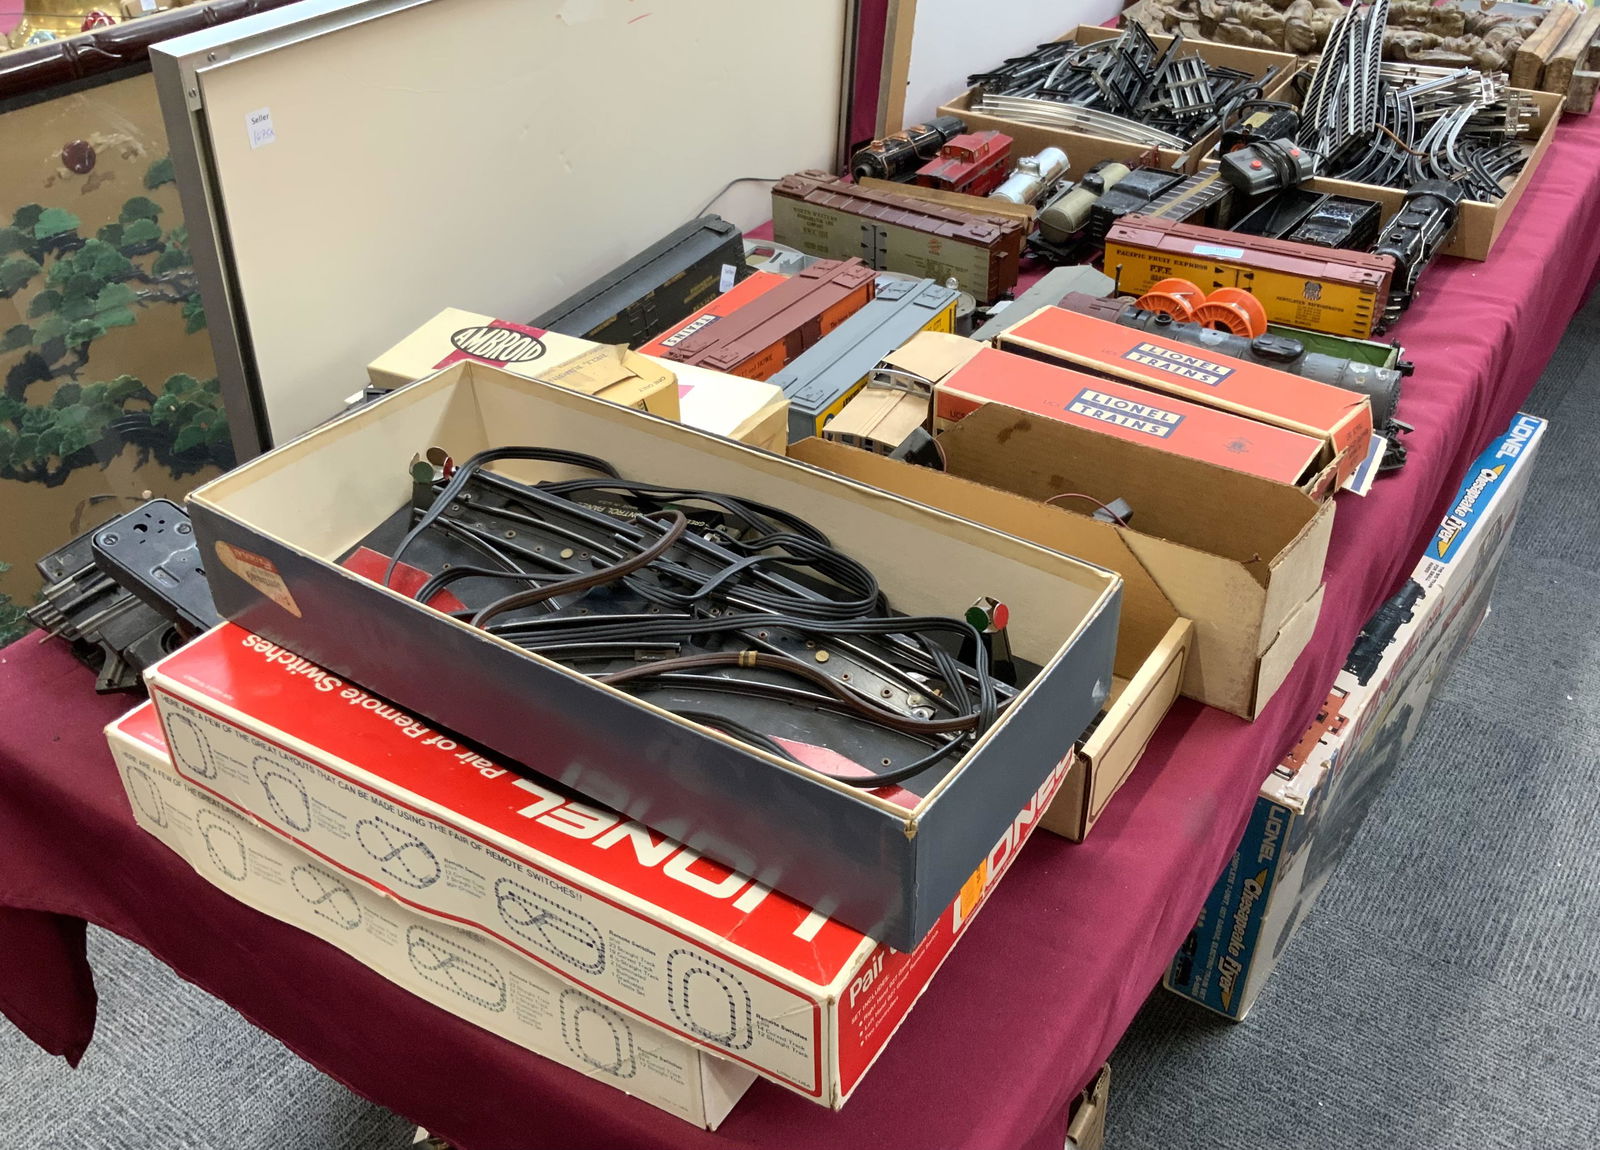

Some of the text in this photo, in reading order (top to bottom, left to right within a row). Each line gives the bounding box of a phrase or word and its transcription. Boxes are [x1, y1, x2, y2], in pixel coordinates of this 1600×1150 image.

[250, 113, 269, 125] Seller
[1116, 249, 1208, 270] PACIFIC FRUIT EXPRESS
[453, 328, 541, 362] AMBROID
[666, 316, 711, 346] TRAINS
[1135, 355, 1210, 383] TRAINS
[1146, 346, 1221, 374] LIONEL
[1080, 405, 1161, 434] TRAINS
[1091, 393, 1171, 422] LIONEL
[1496, 416, 1541, 459] LIONEL
[1438, 468, 1499, 544] Chesapeake Flyer
[241, 634, 343, 692] Switches
[340, 687, 432, 739] Remote
[421, 735, 458, 751] of
[455, 751, 509, 780] Pair
[161, 694, 181, 709] HERE
[182, 705, 198, 717] ARE
[203, 715, 221, 729] FEW
[222, 724, 233, 734] OF
[235, 729, 249, 743] THE
[250, 738, 277, 757] GREAT
[278, 752, 316, 775] LAYOUTS
[316, 769, 338, 786] THAT
[337, 780, 357, 796] CAN
[357, 789, 370, 802] BE
[370, 796, 396, 813] MADE
[396, 808, 427, 828] USING
[428, 820, 448, 835] THE
[470, 840, 484, 852] OF
[485, 848, 524, 873] REMOTE
[525, 868, 584, 903] SWITCHES!!
[952, 749, 1072, 934] LONEL
[1257, 805, 1287, 864] LIONEL
[1217, 878, 1264, 991] Chesapeake Flyer
[850, 950, 885, 1009] Pair
